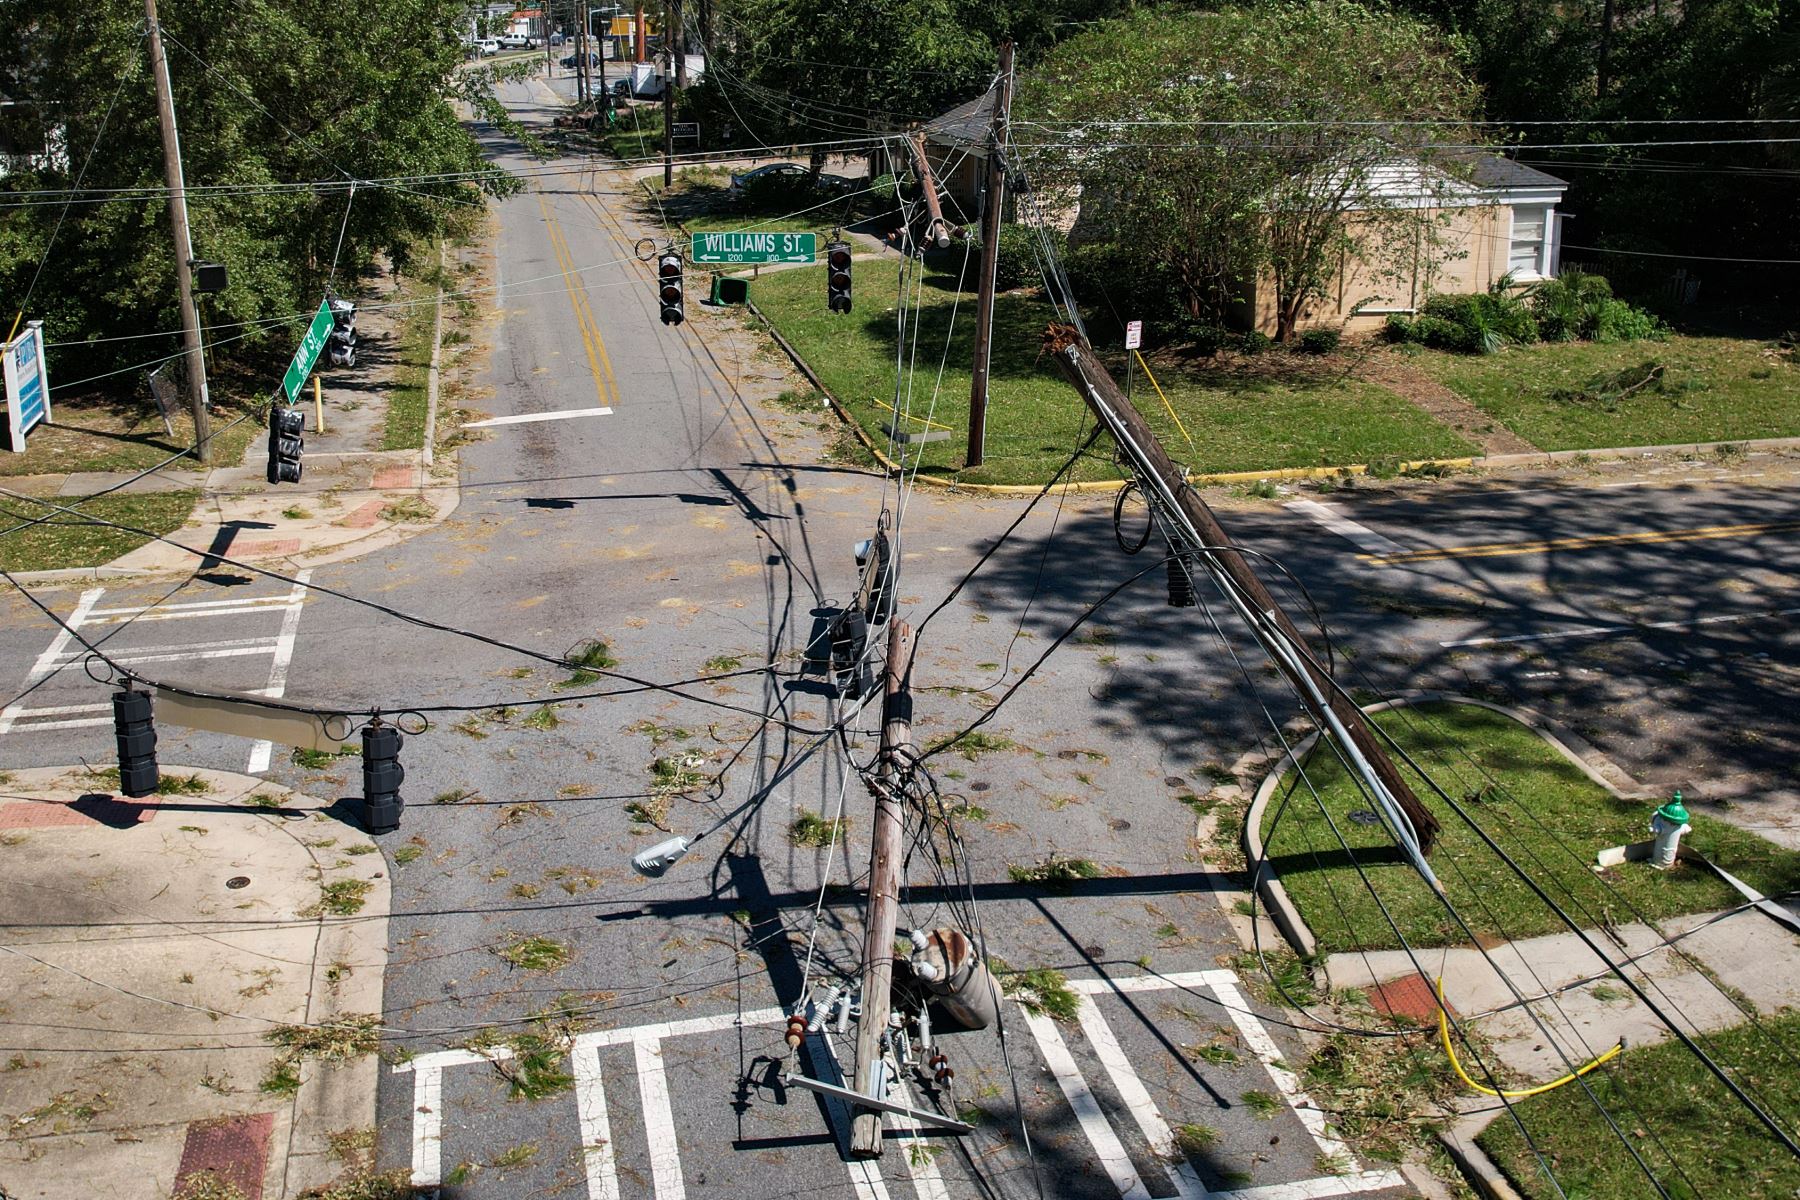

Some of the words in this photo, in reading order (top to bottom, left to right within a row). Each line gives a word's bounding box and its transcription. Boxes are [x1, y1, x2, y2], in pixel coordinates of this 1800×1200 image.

[705, 234, 775, 252] WILLIAMS
[783, 234, 804, 252] ST.
[728, 254, 743, 262] 1200
[766, 254, 779, 262] 1100
[295, 342, 309, 374] ANN
[307, 327, 319, 350] ST.
